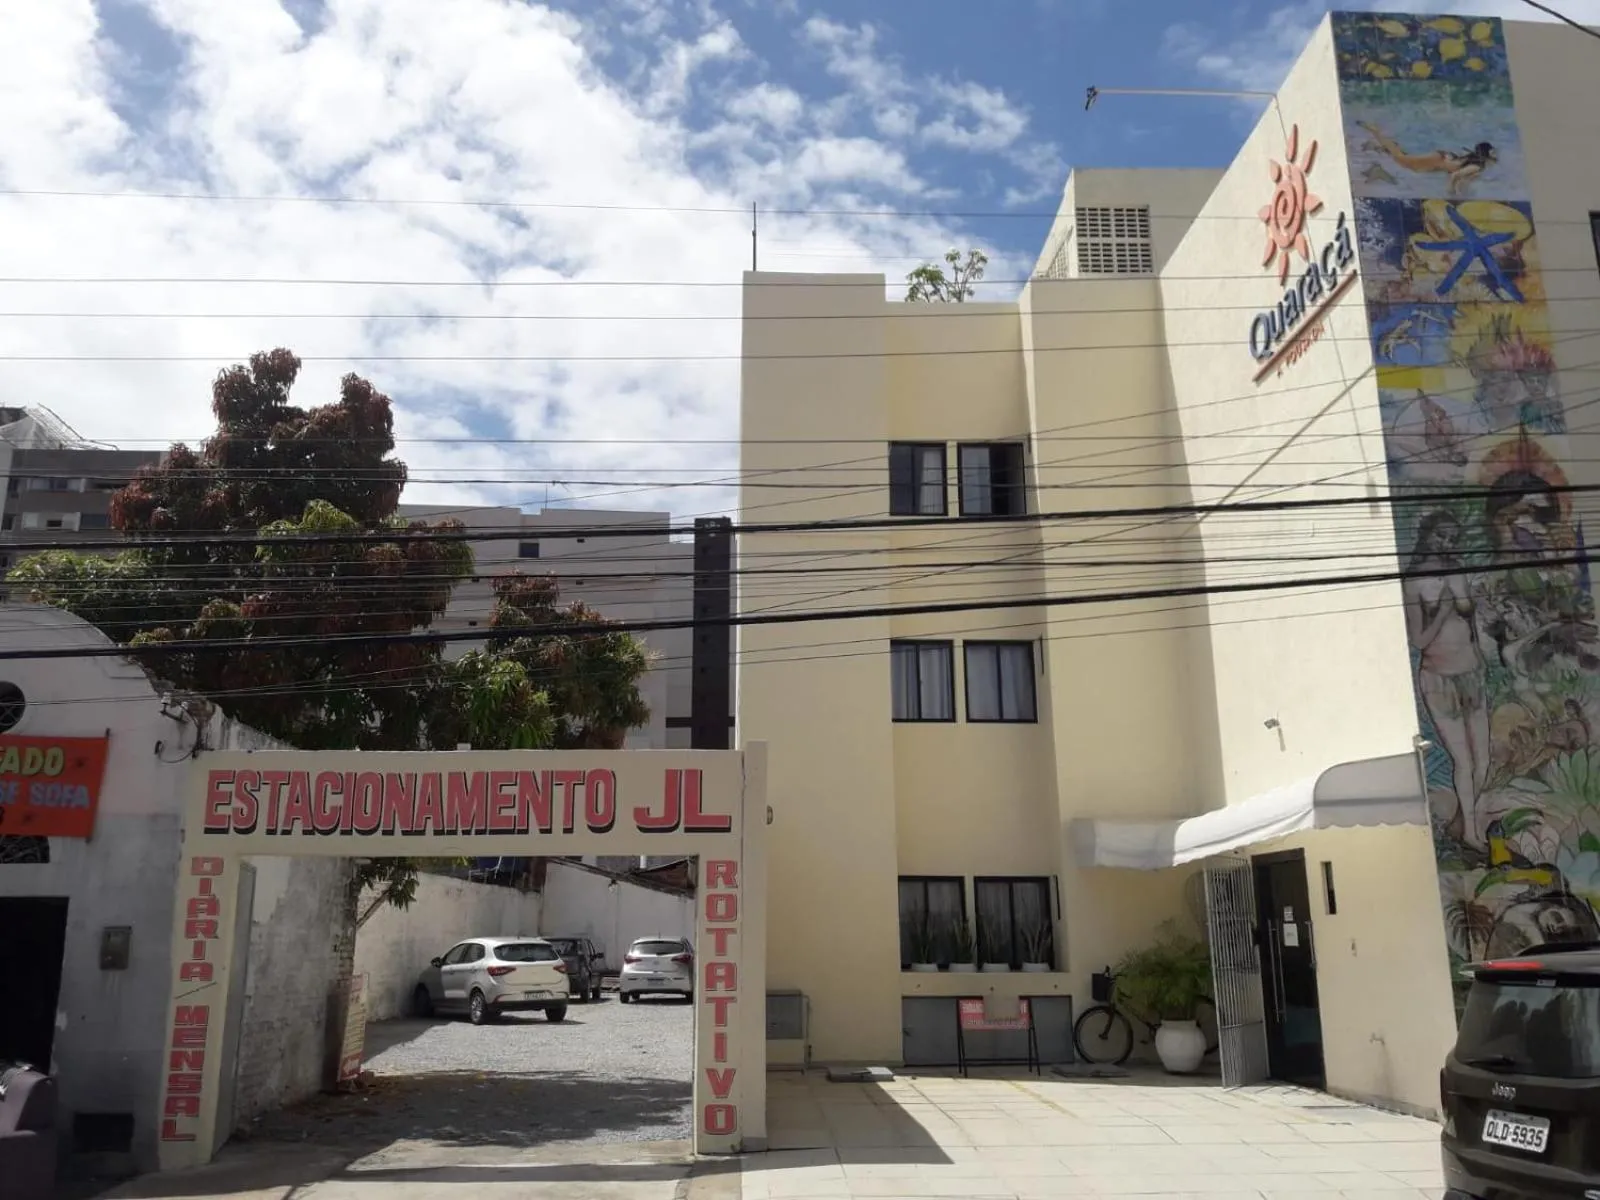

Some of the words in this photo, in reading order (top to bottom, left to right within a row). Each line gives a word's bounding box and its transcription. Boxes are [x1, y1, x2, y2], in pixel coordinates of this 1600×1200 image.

[0, 746, 64, 776] ADO
[204, 768, 617, 836] ESTACIONAMENTO
[633, 769, 731, 834] JL
[704, 860, 738, 1136] ROTATIVO
[160, 1005, 210, 1142] MENSAL
